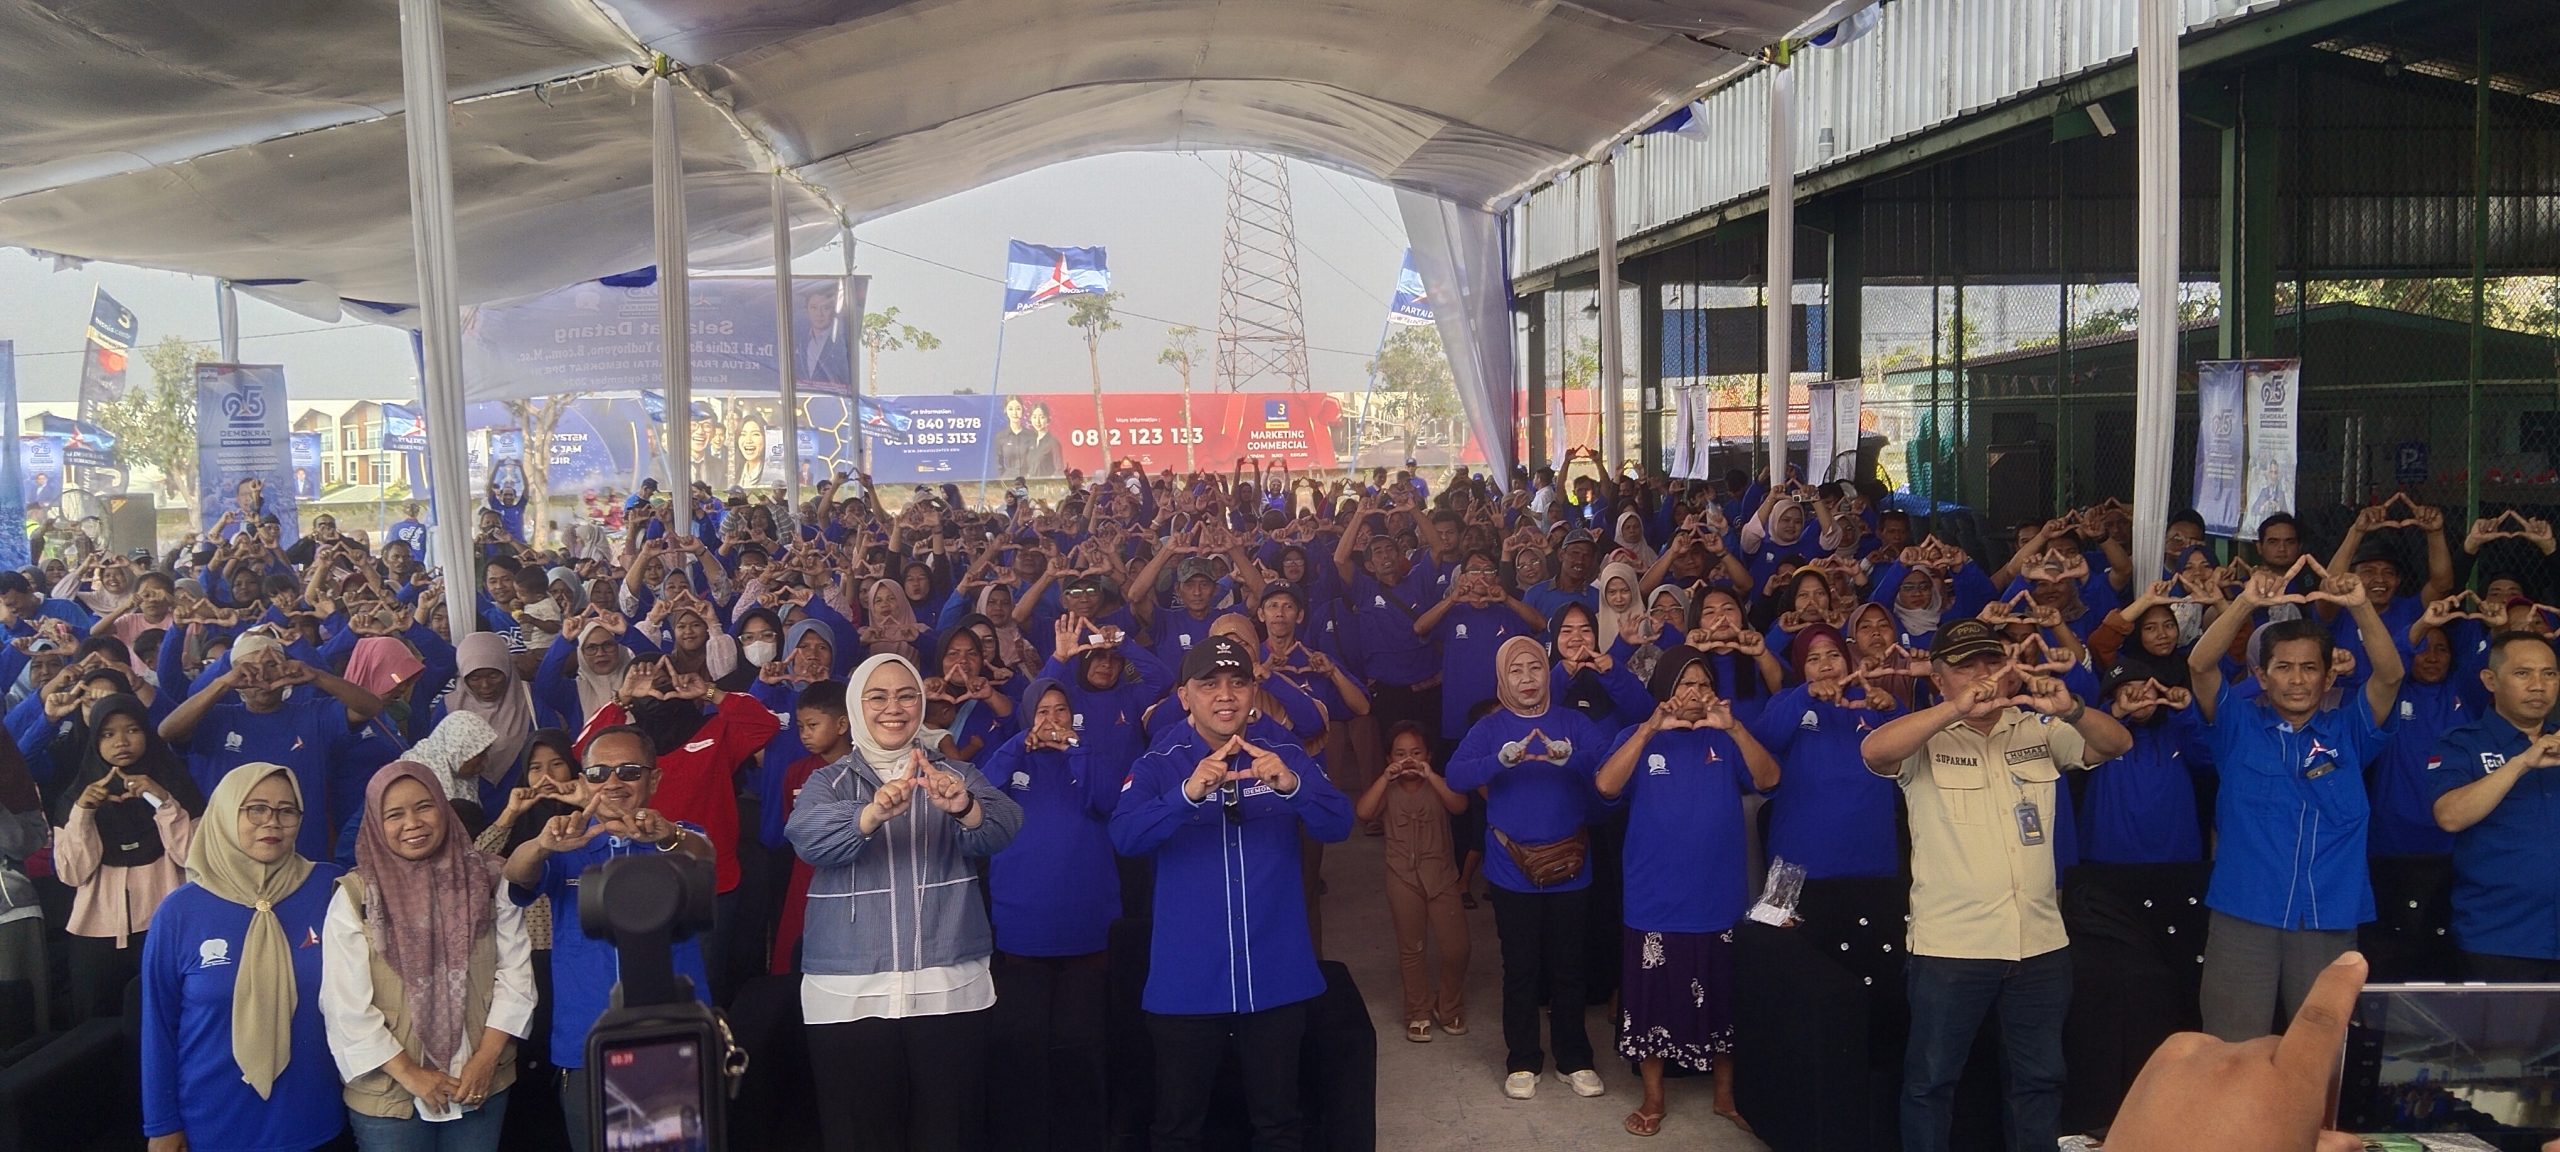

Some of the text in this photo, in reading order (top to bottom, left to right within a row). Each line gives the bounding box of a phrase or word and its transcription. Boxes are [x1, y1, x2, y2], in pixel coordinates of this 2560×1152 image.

[2261, 375, 2287, 406] 25
[222, 385, 266, 421] 25
[1277, 403, 1286, 416] 3
[917, 418, 944, 430] 840
[947, 418, 982, 430] 7878
[917, 433, 944, 445] 895
[947, 432, 977, 444] 3133
[1128, 428, 1163, 445] 123
[1250, 430, 1305, 439] MARKETING
[1247, 441, 1308, 450] COMMERCIAL
[2011, 747, 2042, 757] HUMAS
[1935, 753, 1978, 767] SUPARMAN
